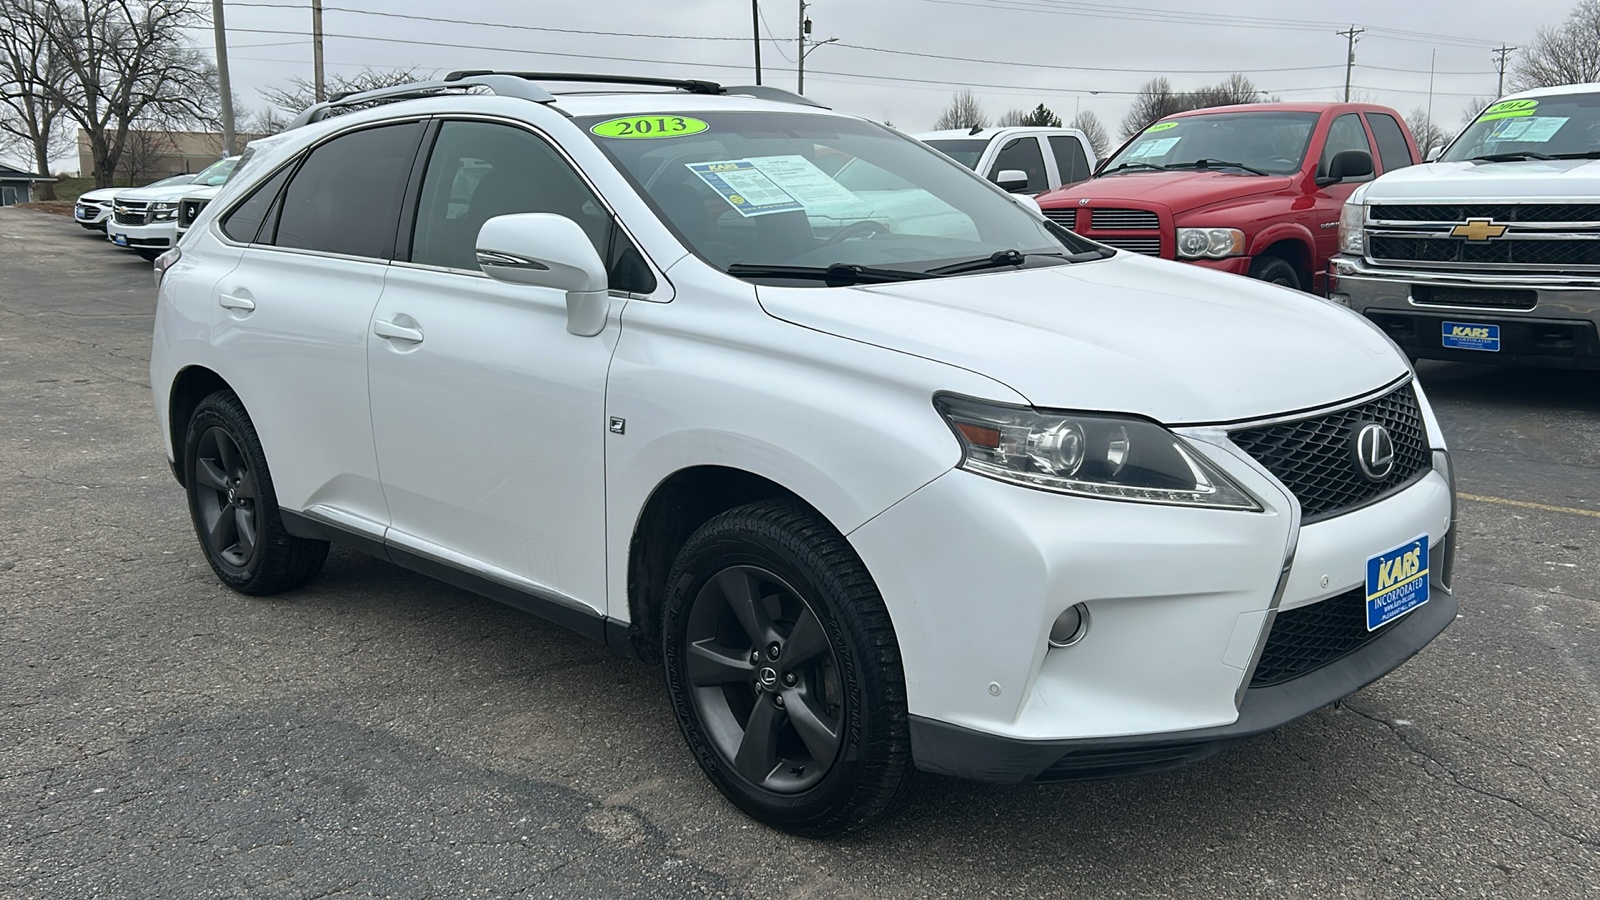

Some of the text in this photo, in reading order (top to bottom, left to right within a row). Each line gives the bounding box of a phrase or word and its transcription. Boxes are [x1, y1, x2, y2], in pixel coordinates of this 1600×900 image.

[616, 117, 688, 136] 2013
[707, 163, 739, 171] KARS
[1452, 326, 1489, 338] KARS
[1378, 547, 1420, 590] KARS
[1374, 577, 1423, 609] INCORPORATED
[827, 616, 860, 750] YOKOHAMA
